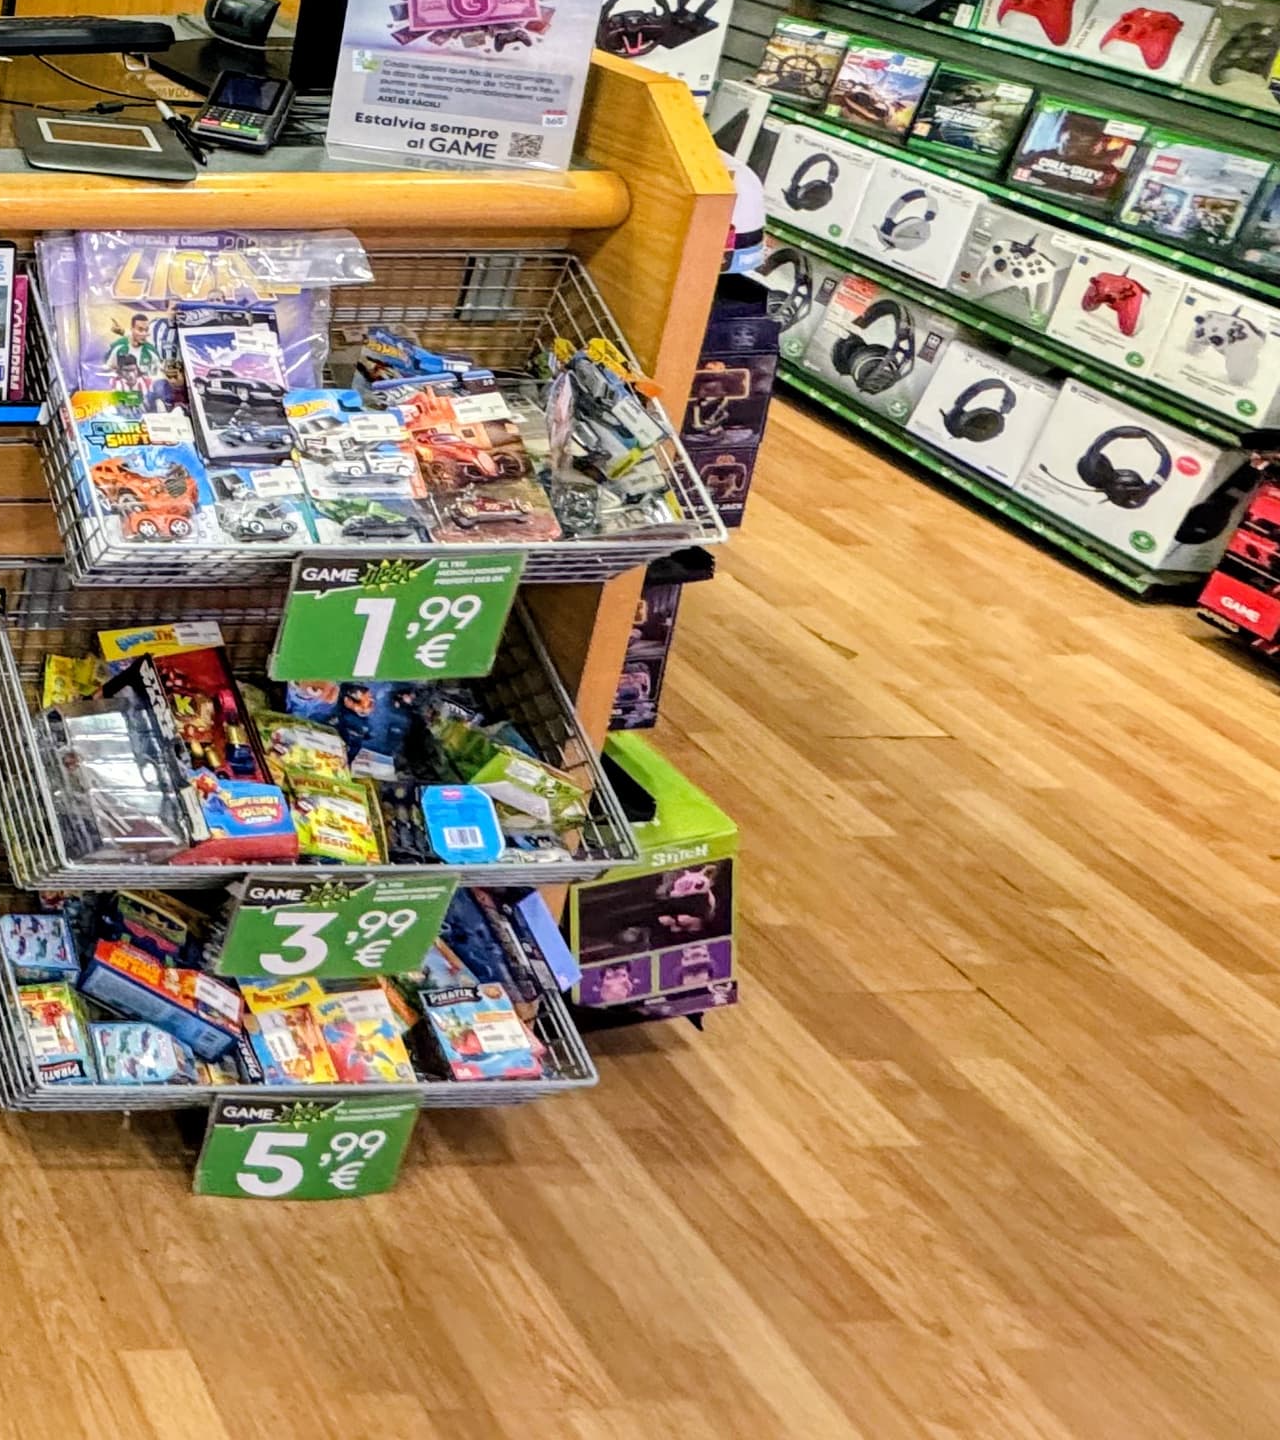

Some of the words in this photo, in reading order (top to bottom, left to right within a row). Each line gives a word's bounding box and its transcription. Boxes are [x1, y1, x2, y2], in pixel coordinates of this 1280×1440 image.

[355, 112, 425, 133] Estalvia
[430, 123, 500, 140] sempre
[407, 138, 424, 150] al
[429, 138, 497, 159] GAME
[302, 568, 358, 582] GAME
[406, 595, 482, 639] ,99
[352, 598, 396, 677] 1
[415, 634, 456, 668] €
[250, 888, 303, 900] GAME
[345, 909, 417, 944] ,99
[259, 913, 339, 975] 3
[353, 940, 391, 968] €
[223, 1106, 274, 1120] GAME
[319, 1130, 386, 1165] ,99
[237, 1133, 309, 1196] 5
[329, 1162, 362, 1190] €
